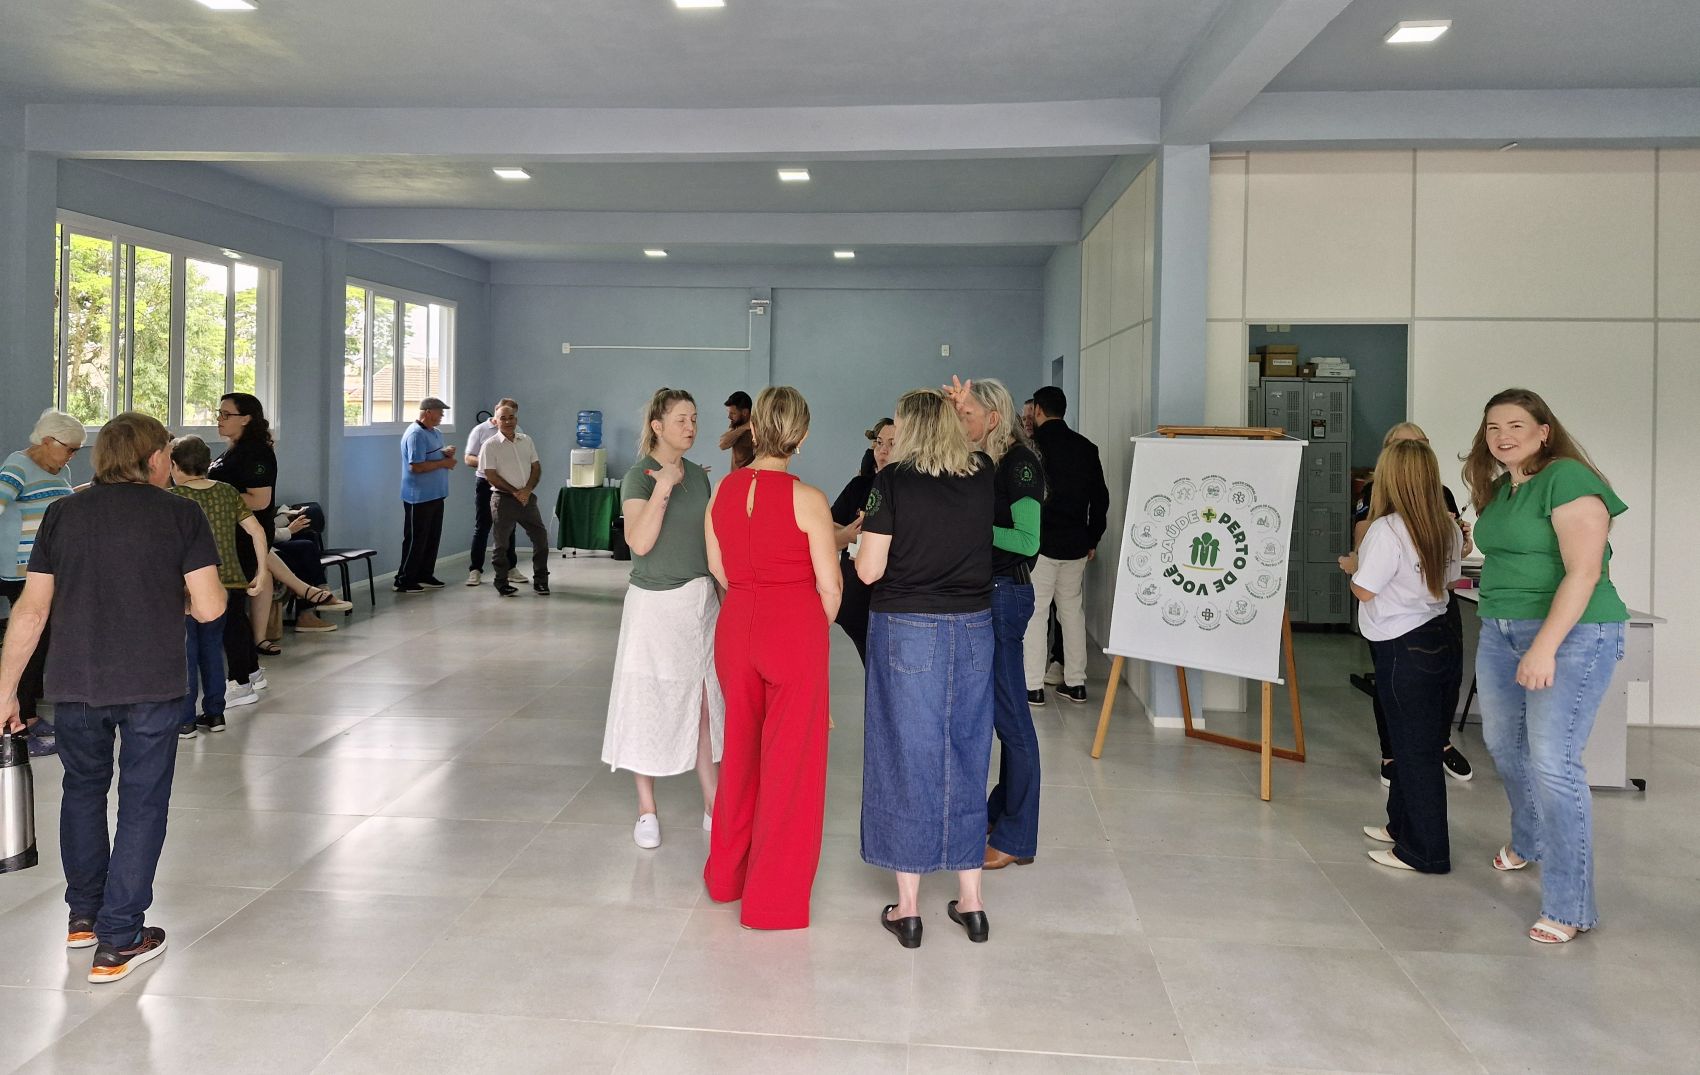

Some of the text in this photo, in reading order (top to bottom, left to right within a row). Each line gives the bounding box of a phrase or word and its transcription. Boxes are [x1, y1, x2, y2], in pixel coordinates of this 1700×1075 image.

[1161, 510, 1200, 563] SAÚDE
[1218, 512, 1248, 570] PERTO
[1163, 564, 1209, 596] VOCÊ
[1213, 571, 1238, 594] DE
